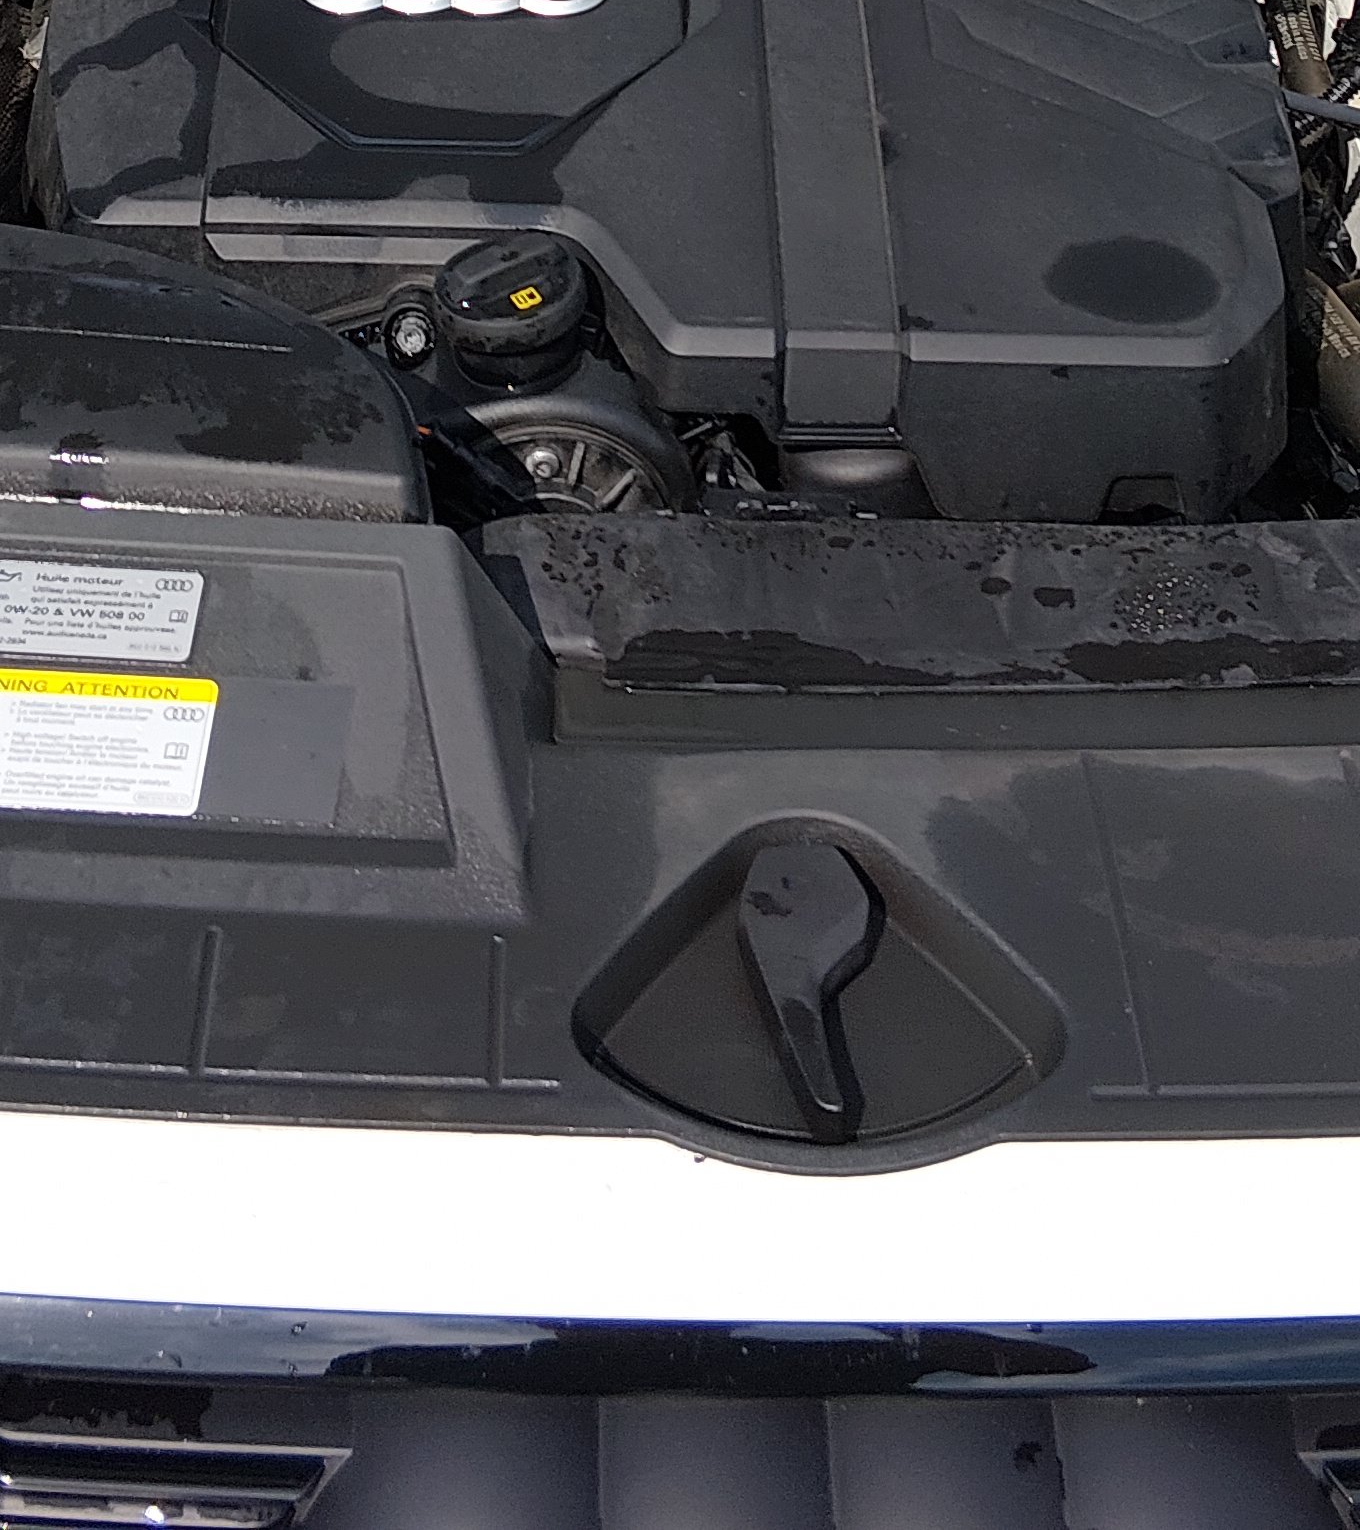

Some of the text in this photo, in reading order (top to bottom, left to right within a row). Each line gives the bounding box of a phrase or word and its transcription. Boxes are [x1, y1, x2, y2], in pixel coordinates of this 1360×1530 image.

[36, 573, 124, 587] Huile moteur
[4, 604, 50, 616] 0W-20
[53, 608, 65, 617] &
[70, 608, 96, 618] VW
[99, 610, 124, 620] 508
[128, 612, 146, 622] 00
[62, 680, 180, 700] ATTENTION
